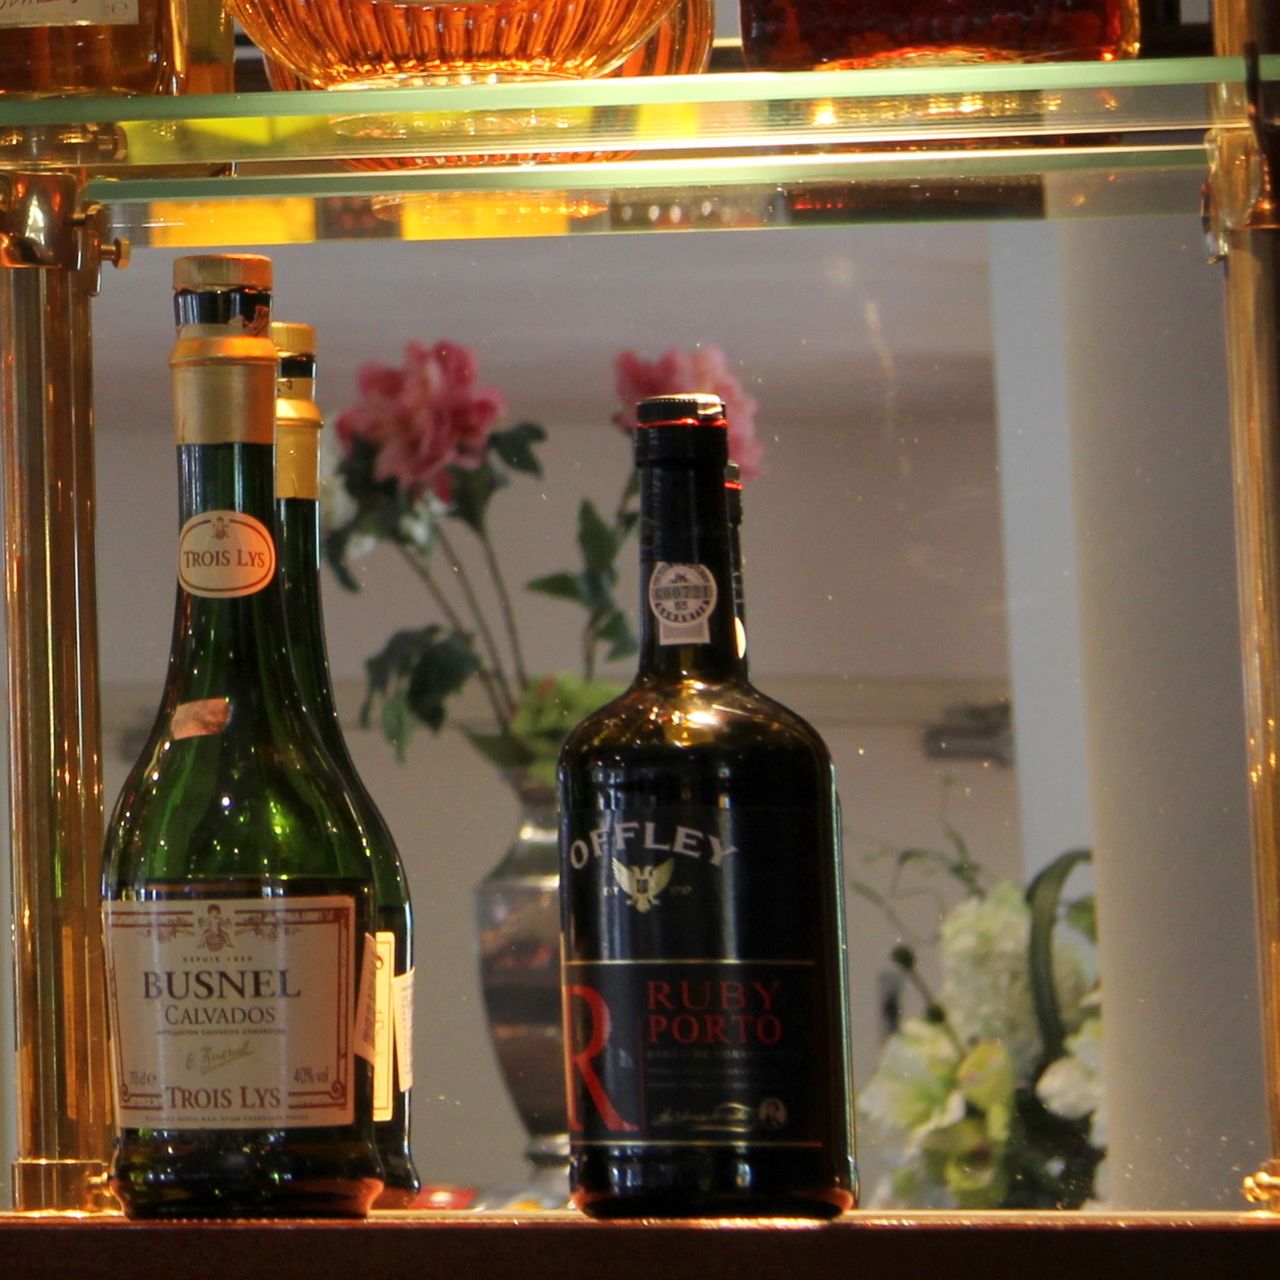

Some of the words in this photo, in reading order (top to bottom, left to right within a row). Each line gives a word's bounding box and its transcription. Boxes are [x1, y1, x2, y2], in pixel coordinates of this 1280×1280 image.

[182, 549, 232, 571] TROIS
[236, 549, 266, 570] LYS
[569, 820, 739, 870] OFFLEY
[142, 969, 302, 1001] BUSNEL
[647, 980, 782, 1012] RUBY
[165, 1004, 276, 1026] CALVADOS
[647, 1014, 784, 1046] PORTO
[165, 1086, 233, 1110] TROIS
[239, 1085, 281, 1108] LYS
